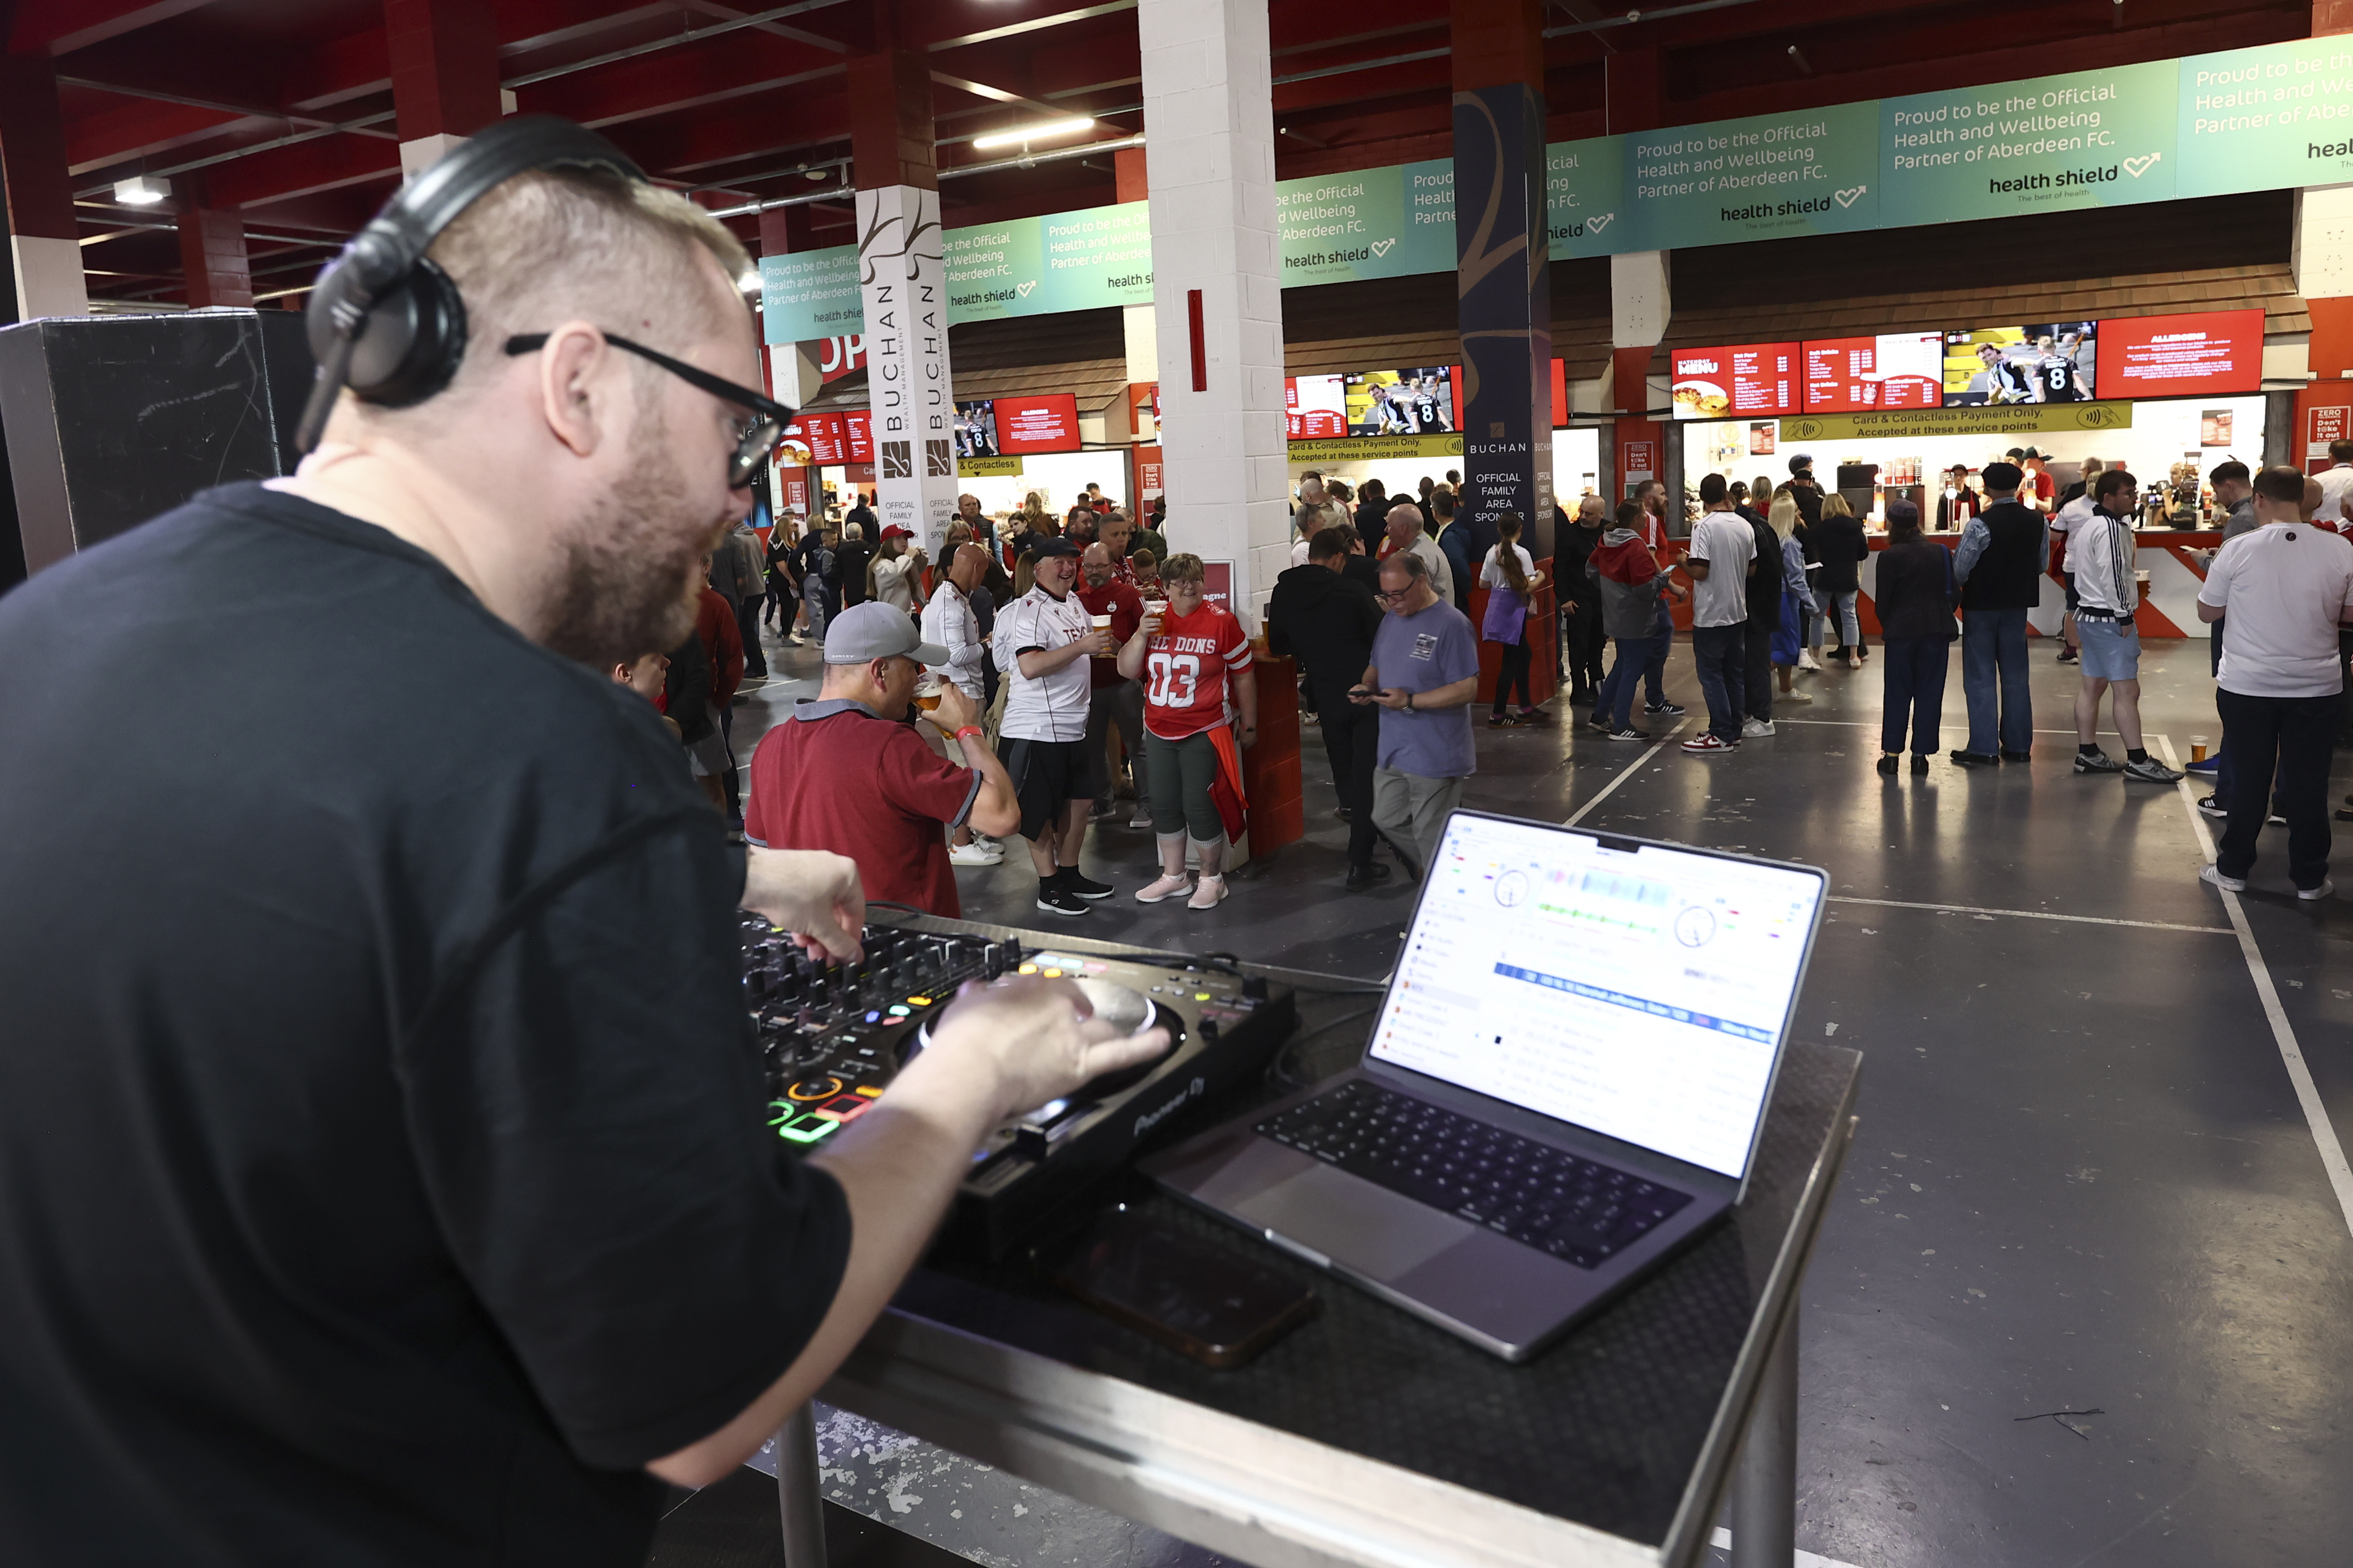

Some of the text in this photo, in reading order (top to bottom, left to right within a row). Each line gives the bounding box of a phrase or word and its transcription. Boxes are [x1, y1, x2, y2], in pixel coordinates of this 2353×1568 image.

[2197, 58, 2323, 87] Proud to be
[2196, 80, 2315, 111] Health and
[1895, 84, 2116, 126] Proud to be the Official
[2195, 106, 2303, 135] Partner of
[1895, 112, 2101, 148] Health and Wellbeing
[1638, 122, 1827, 159] Proud to be the Official
[2308, 138, 2353, 159] heal
[1894, 131, 2115, 169] Partner of Aberdeen FC.
[1638, 147, 1814, 178] Health and Wellbeing
[1414, 171, 1454, 188] Proud
[1638, 165, 1827, 198] Partner of Aberdeen FC.
[1990, 165, 2118, 193] health shield
[1293, 183, 1364, 204] the Official
[2064, 189, 2089, 198] health
[1289, 204, 1356, 222] Wellbeing
[1721, 197, 1831, 221] health shield
[1049, 215, 1131, 238] Proud to be the
[1282, 220, 1366, 241] Aberdeen FC.
[955, 232, 1011, 250] the Official
[1050, 235, 1108, 253] Health and
[953, 250, 1004, 267] Wellbeing
[1051, 252, 1103, 270] Partner of
[1285, 248, 1369, 268] health shield
[766, 259, 830, 277] Proud to be the
[949, 265, 1013, 282] Aberdeen FC.
[767, 271, 860, 292] Health and Wellbeing
[1108, 273, 1143, 288] health
[769, 287, 853, 306] Partner of Aberdeen
[951, 289, 1016, 306] health shield
[814, 307, 864, 323] health shiel
[2150, 332, 2207, 343] ALLERGENS
[877, 285, 902, 431] BUCHAN
[898, 327, 907, 392] MANAGEMENT
[921, 285, 943, 429] BUCHAN
[938, 329, 946, 390] MANAGEMENT
[1678, 362, 1718, 375] MENU
[2050, 368, 2065, 390] 8
[1422, 404, 1433, 423] 8
[1853, 416, 1878, 425] Card
[1892, 412, 1957, 422] Contactless
[1961, 409, 2011, 421] Payment
[1857, 421, 2038, 438] Accepted at these service points
[974, 433, 983, 448] 8
[1287, 442, 1305, 451] Card
[1308, 442, 1313, 450] &
[1315, 441, 1361, 450] Contactless
[1364, 439, 1399, 449] Payment
[1470, 443, 1526, 454] BUCHAN
[1535, 442, 1552, 451] BUCHAN
[1291, 453, 1327, 462] Accepted
[1338, 451, 1360, 459] these
[1393, 449, 1418, 458] points
[967, 460, 1015, 470] Contactless
[1476, 472, 1522, 483] OFFICIAL
[1537, 472, 1551, 481] OFFICIAL
[1481, 486, 1516, 496] FAMILY
[1538, 484, 1550, 494] FAMILY
[930, 499, 954, 507] OFFICIAL
[1485, 499, 1513, 509] AREA
[1540, 498, 1549, 507] AREA
[1475, 512, 1525, 522] SPONR
[1537, 509, 1553, 521] SPONSOR
[1202, 593, 1227, 602] agne
[1148, 636, 1217, 654] HE DONS
[1148, 652, 1200, 708] 03
